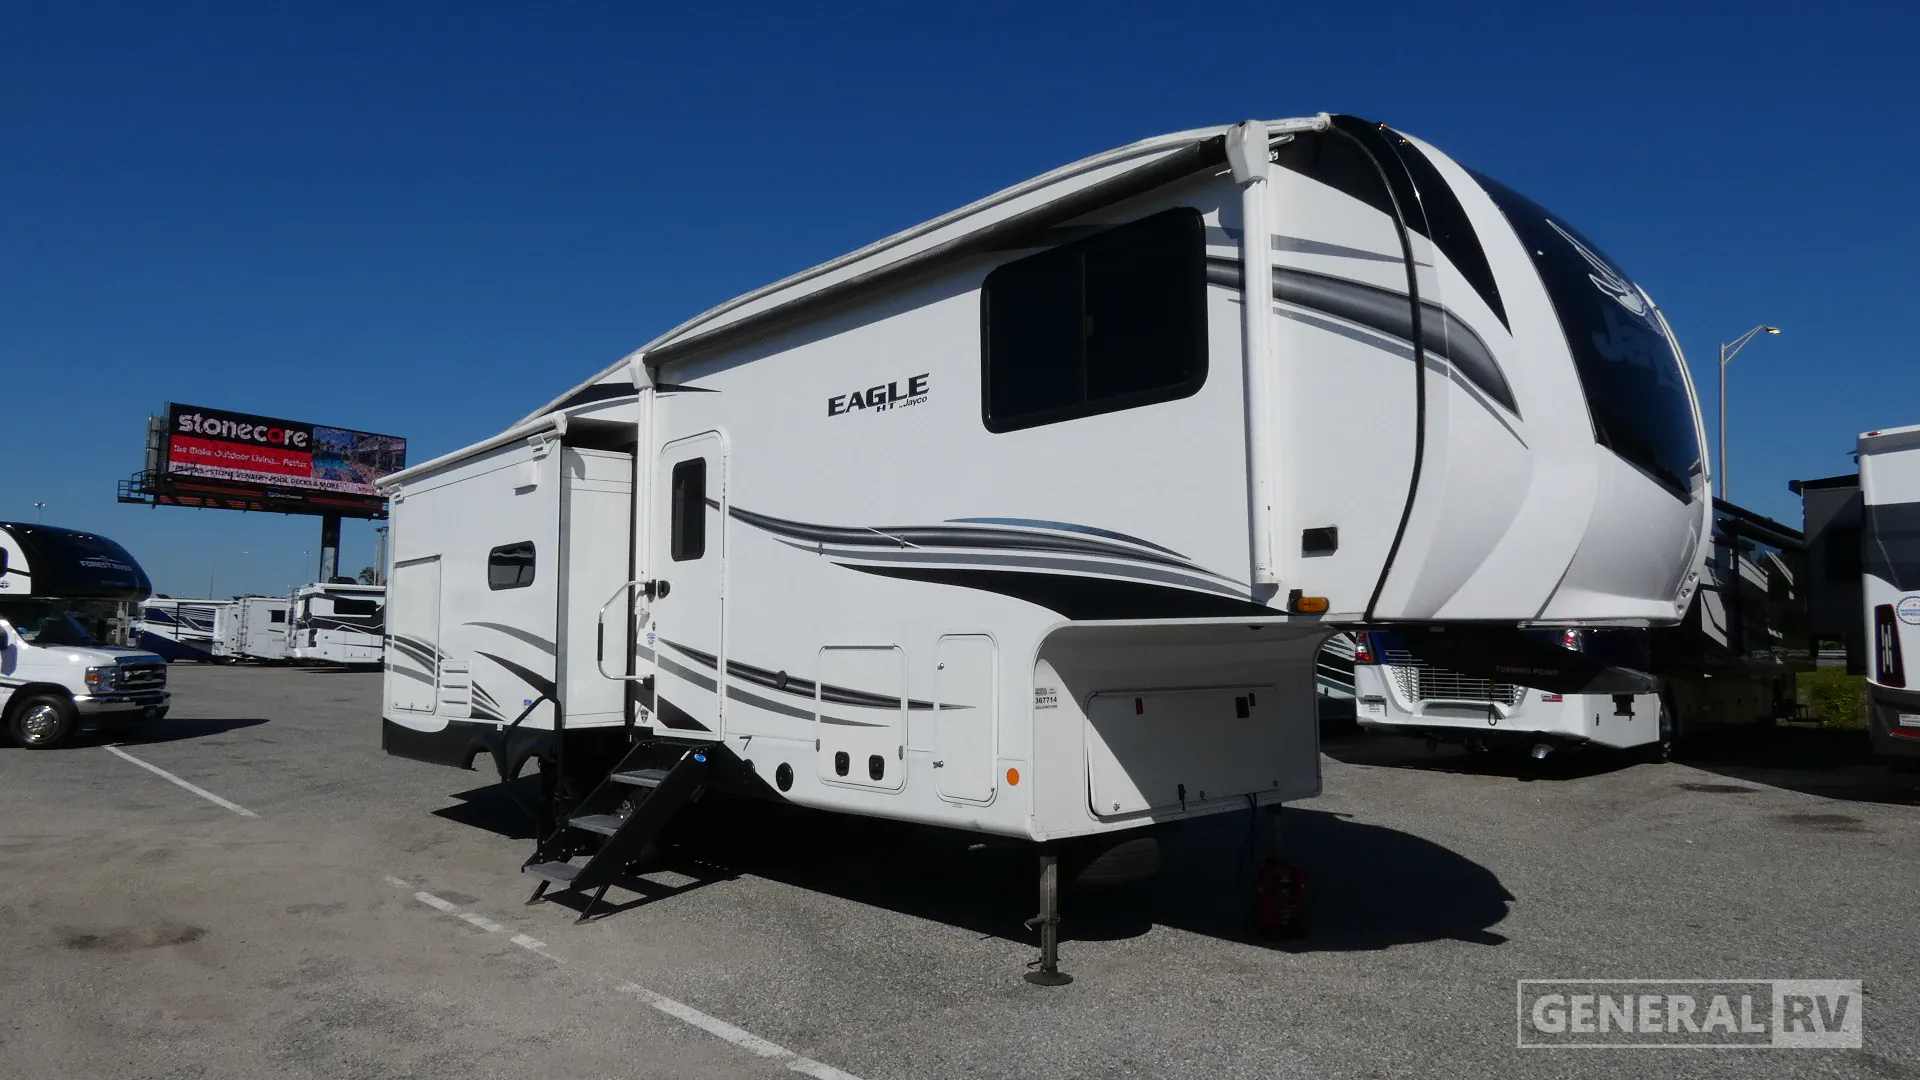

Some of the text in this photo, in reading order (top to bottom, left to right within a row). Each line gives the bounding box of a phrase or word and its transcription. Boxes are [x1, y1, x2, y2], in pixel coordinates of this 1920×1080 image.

[828, 372, 930, 417] EAGLE
[904, 396, 928, 408] Jayco
[178, 412, 308, 448] stonecore
[190, 446, 212, 456] Make
[214, 449, 250, 461] Outdoor
[291, 479, 312, 487] DECKS
[80, 560, 112, 568] FOREST
[1495, 665, 1559, 677] TURNING POINT
